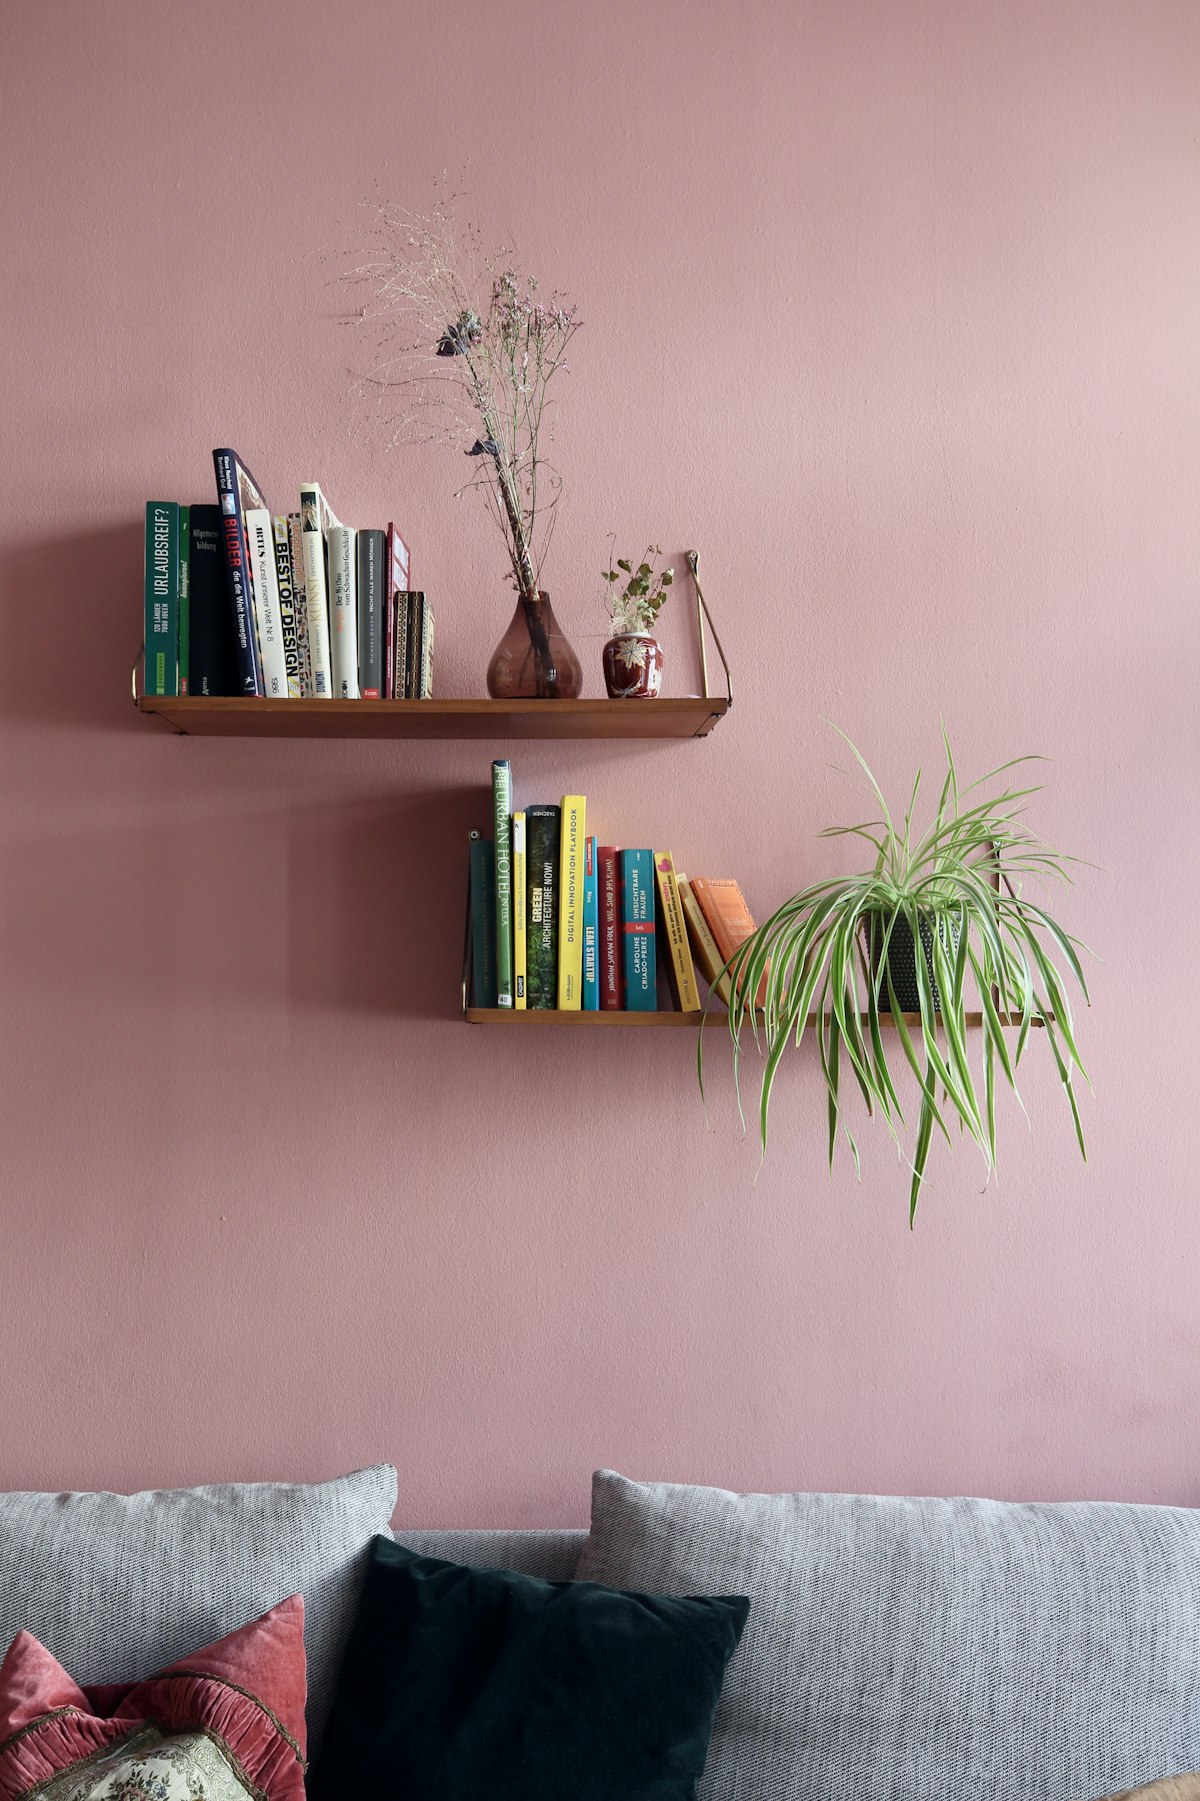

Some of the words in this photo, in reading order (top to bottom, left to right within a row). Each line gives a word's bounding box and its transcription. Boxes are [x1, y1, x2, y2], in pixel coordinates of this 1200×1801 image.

[193, 528, 220, 539] Allgemein-
[225, 519, 242, 566] BILDER
[155, 509, 168, 595] URLAUBSREIF?
[197, 539, 216, 552] bildung
[260, 561, 268, 580] Kunst
[277, 542, 290, 585] BEST
[232, 570, 241, 582] die
[335, 573, 343, 594] Mythos
[234, 583, 243, 594] die
[262, 582, 270, 607] unserer
[281, 588, 292, 609] OF
[308, 577, 321, 622] KUNST
[235, 596, 245, 612] Welt
[238, 614, 247, 648] bewegten
[282, 614, 298, 677] DESIGN
[271, 677, 279, 693] 1986
[315, 670, 325, 693] DUMONT
[496, 790, 509, 843] URBAN
[496, 849, 510, 898] HOTEL
[544, 862, 552, 884] NOW!
[662, 882, 670, 902] anders
[532, 888, 542, 922] GREEN
[543, 887, 553, 948] ARCHITECTURE
[586, 927, 595, 944] LEAN
[586, 947, 594, 982] STARTUP
